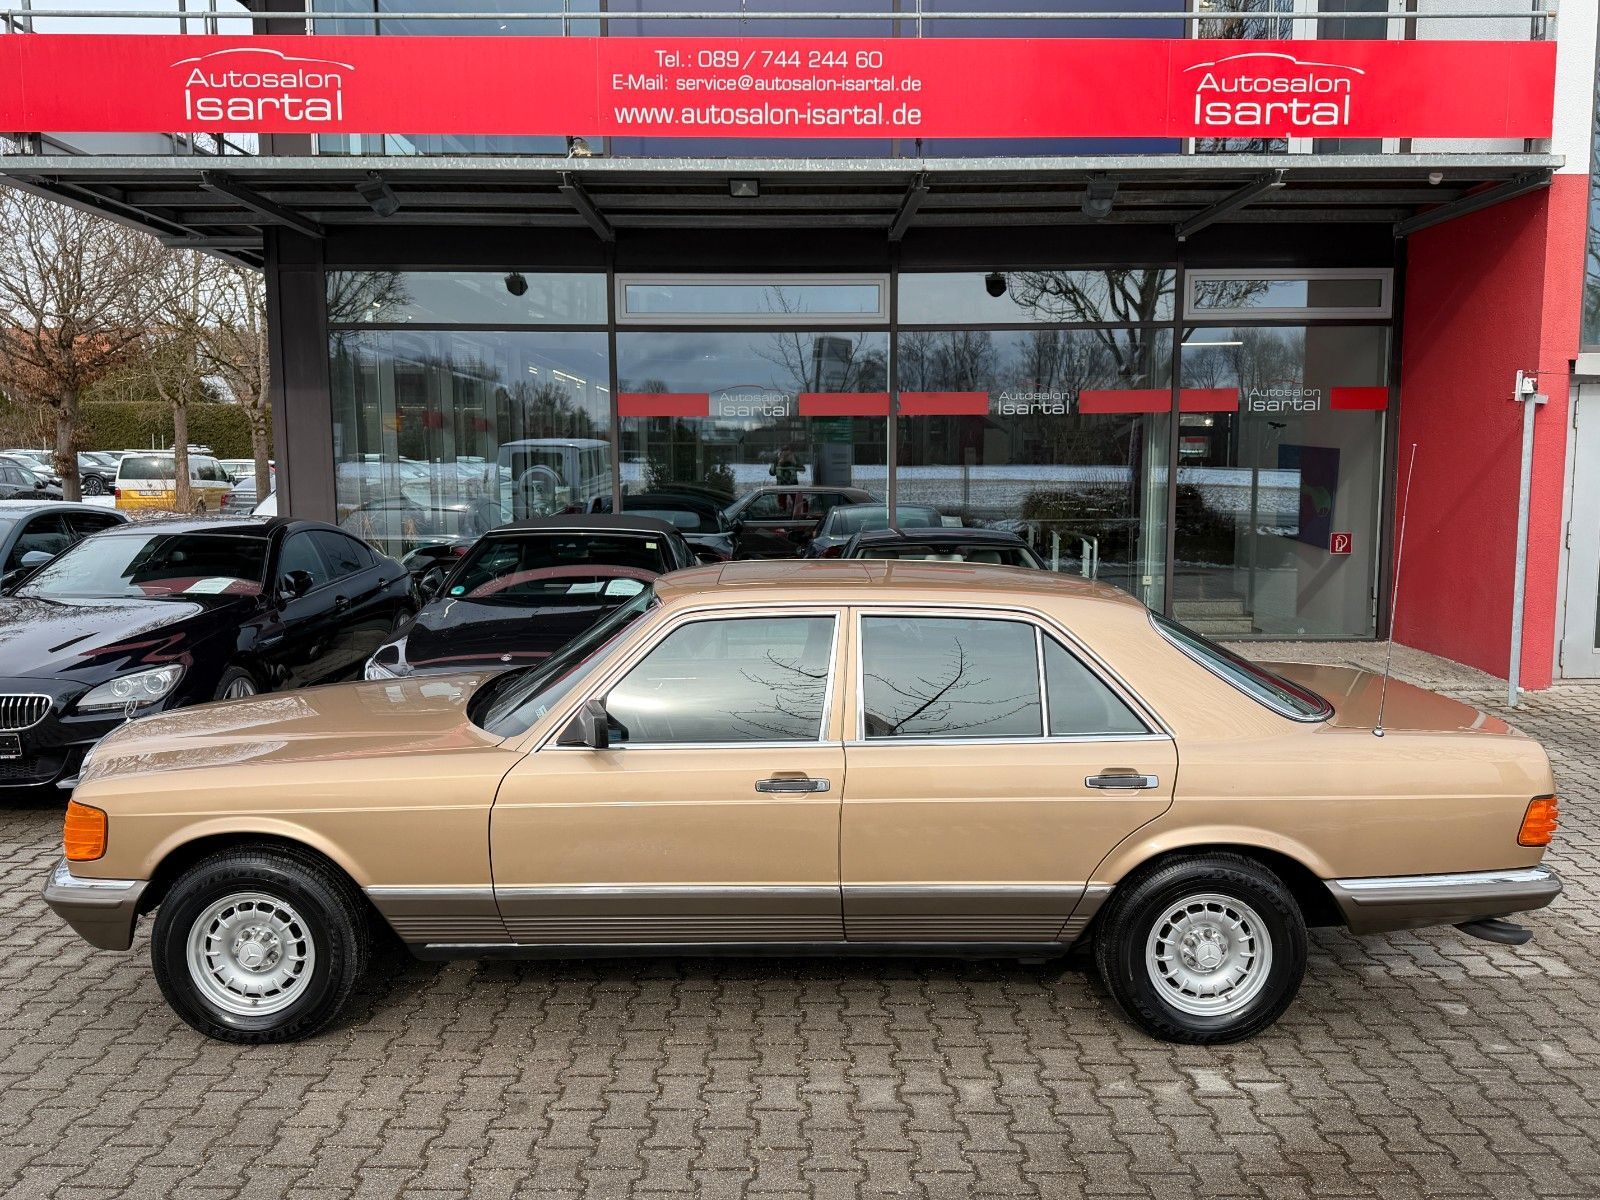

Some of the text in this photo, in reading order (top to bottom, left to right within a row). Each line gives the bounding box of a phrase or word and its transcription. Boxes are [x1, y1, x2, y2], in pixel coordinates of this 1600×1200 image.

[654, 49, 883, 70] Tel.: 089 / 744 244 60
[186, 68, 342, 89] Autosalon
[612, 73, 922, 92] E-Mail: service@autosalon-isartal.de
[1196, 72, 1351, 93] Autosalon
[185, 89, 343, 121] Isartal
[614, 102, 922, 125] www.autosalon-isartal.de
[1194, 93, 1350, 126] Isartal
[719, 392, 790, 402] Autosalon
[1000, 391, 1070, 400] Autosalon
[1249, 387, 1321, 397] Autosalon
[718, 402, 790, 417] Isartal
[998, 400, 1070, 415] Isartal
[1248, 396, 1321, 412] Isartal
